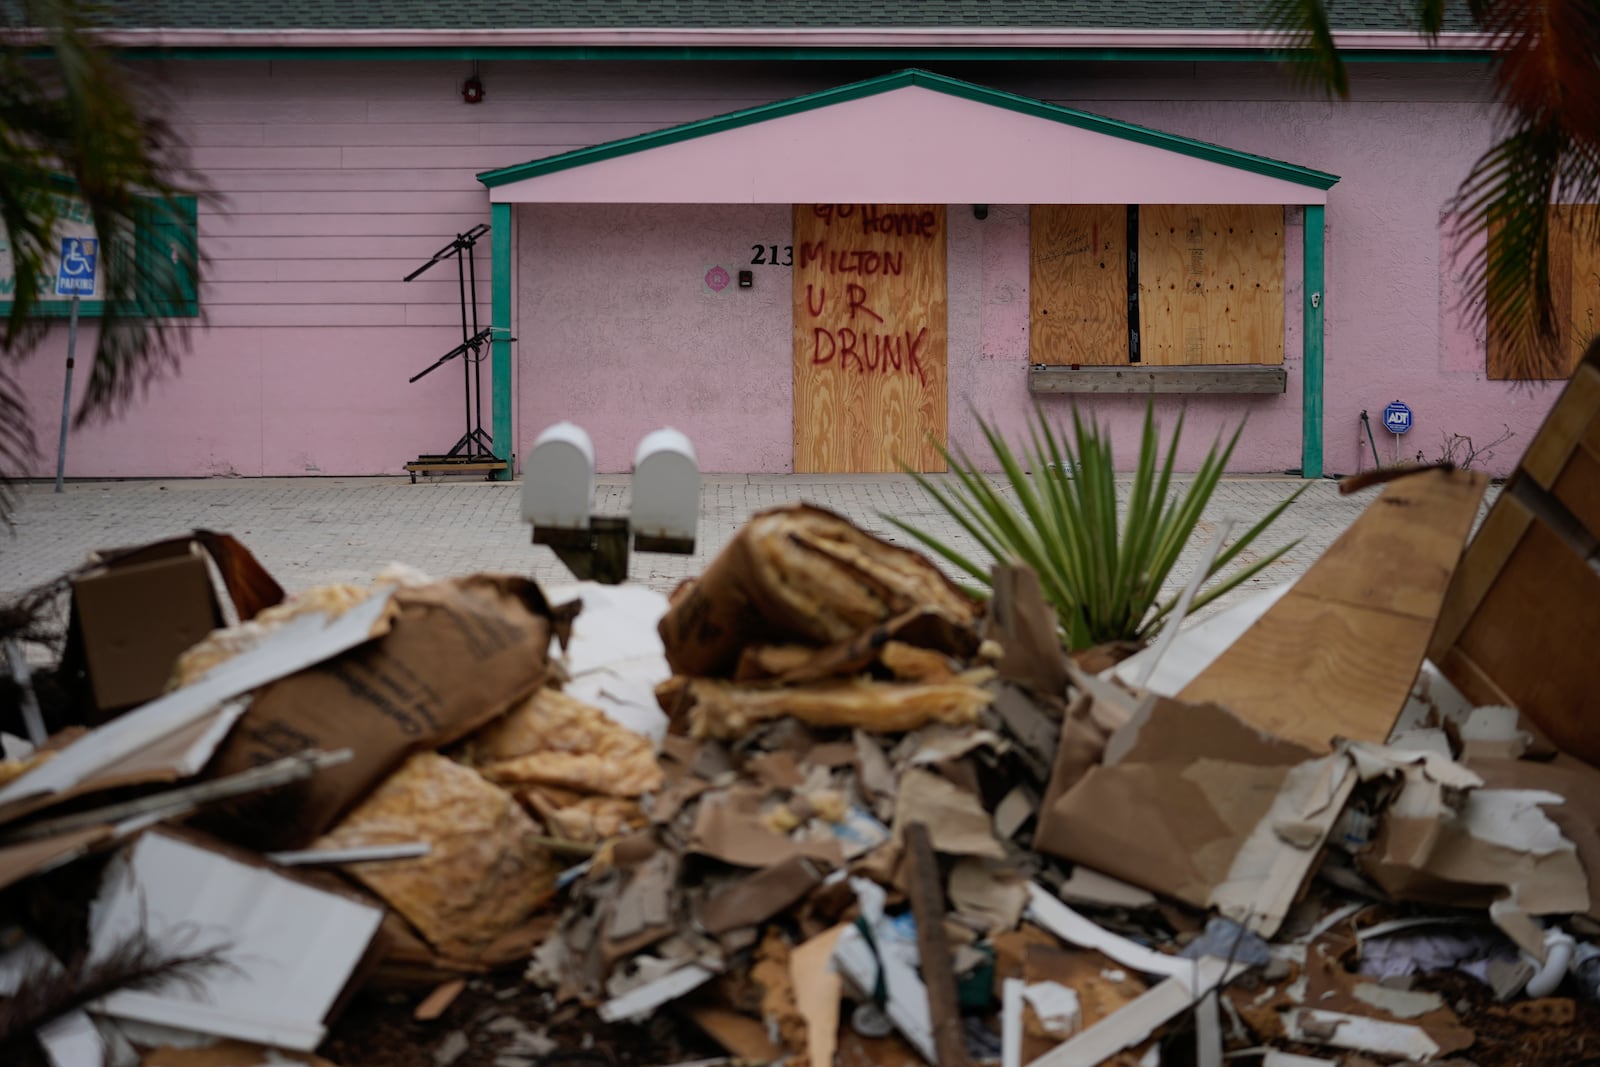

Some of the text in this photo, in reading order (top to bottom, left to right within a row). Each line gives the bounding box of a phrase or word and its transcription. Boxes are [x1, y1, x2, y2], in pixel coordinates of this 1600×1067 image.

[861, 204, 935, 238] Home
[751, 244, 793, 266] 213
[800, 240, 903, 276] MILTON
[60, 277, 94, 291] PARKING
[807, 284, 884, 323] U R
[813, 327, 928, 388] DRUNK
[1388, 412, 1408, 425] ADT
